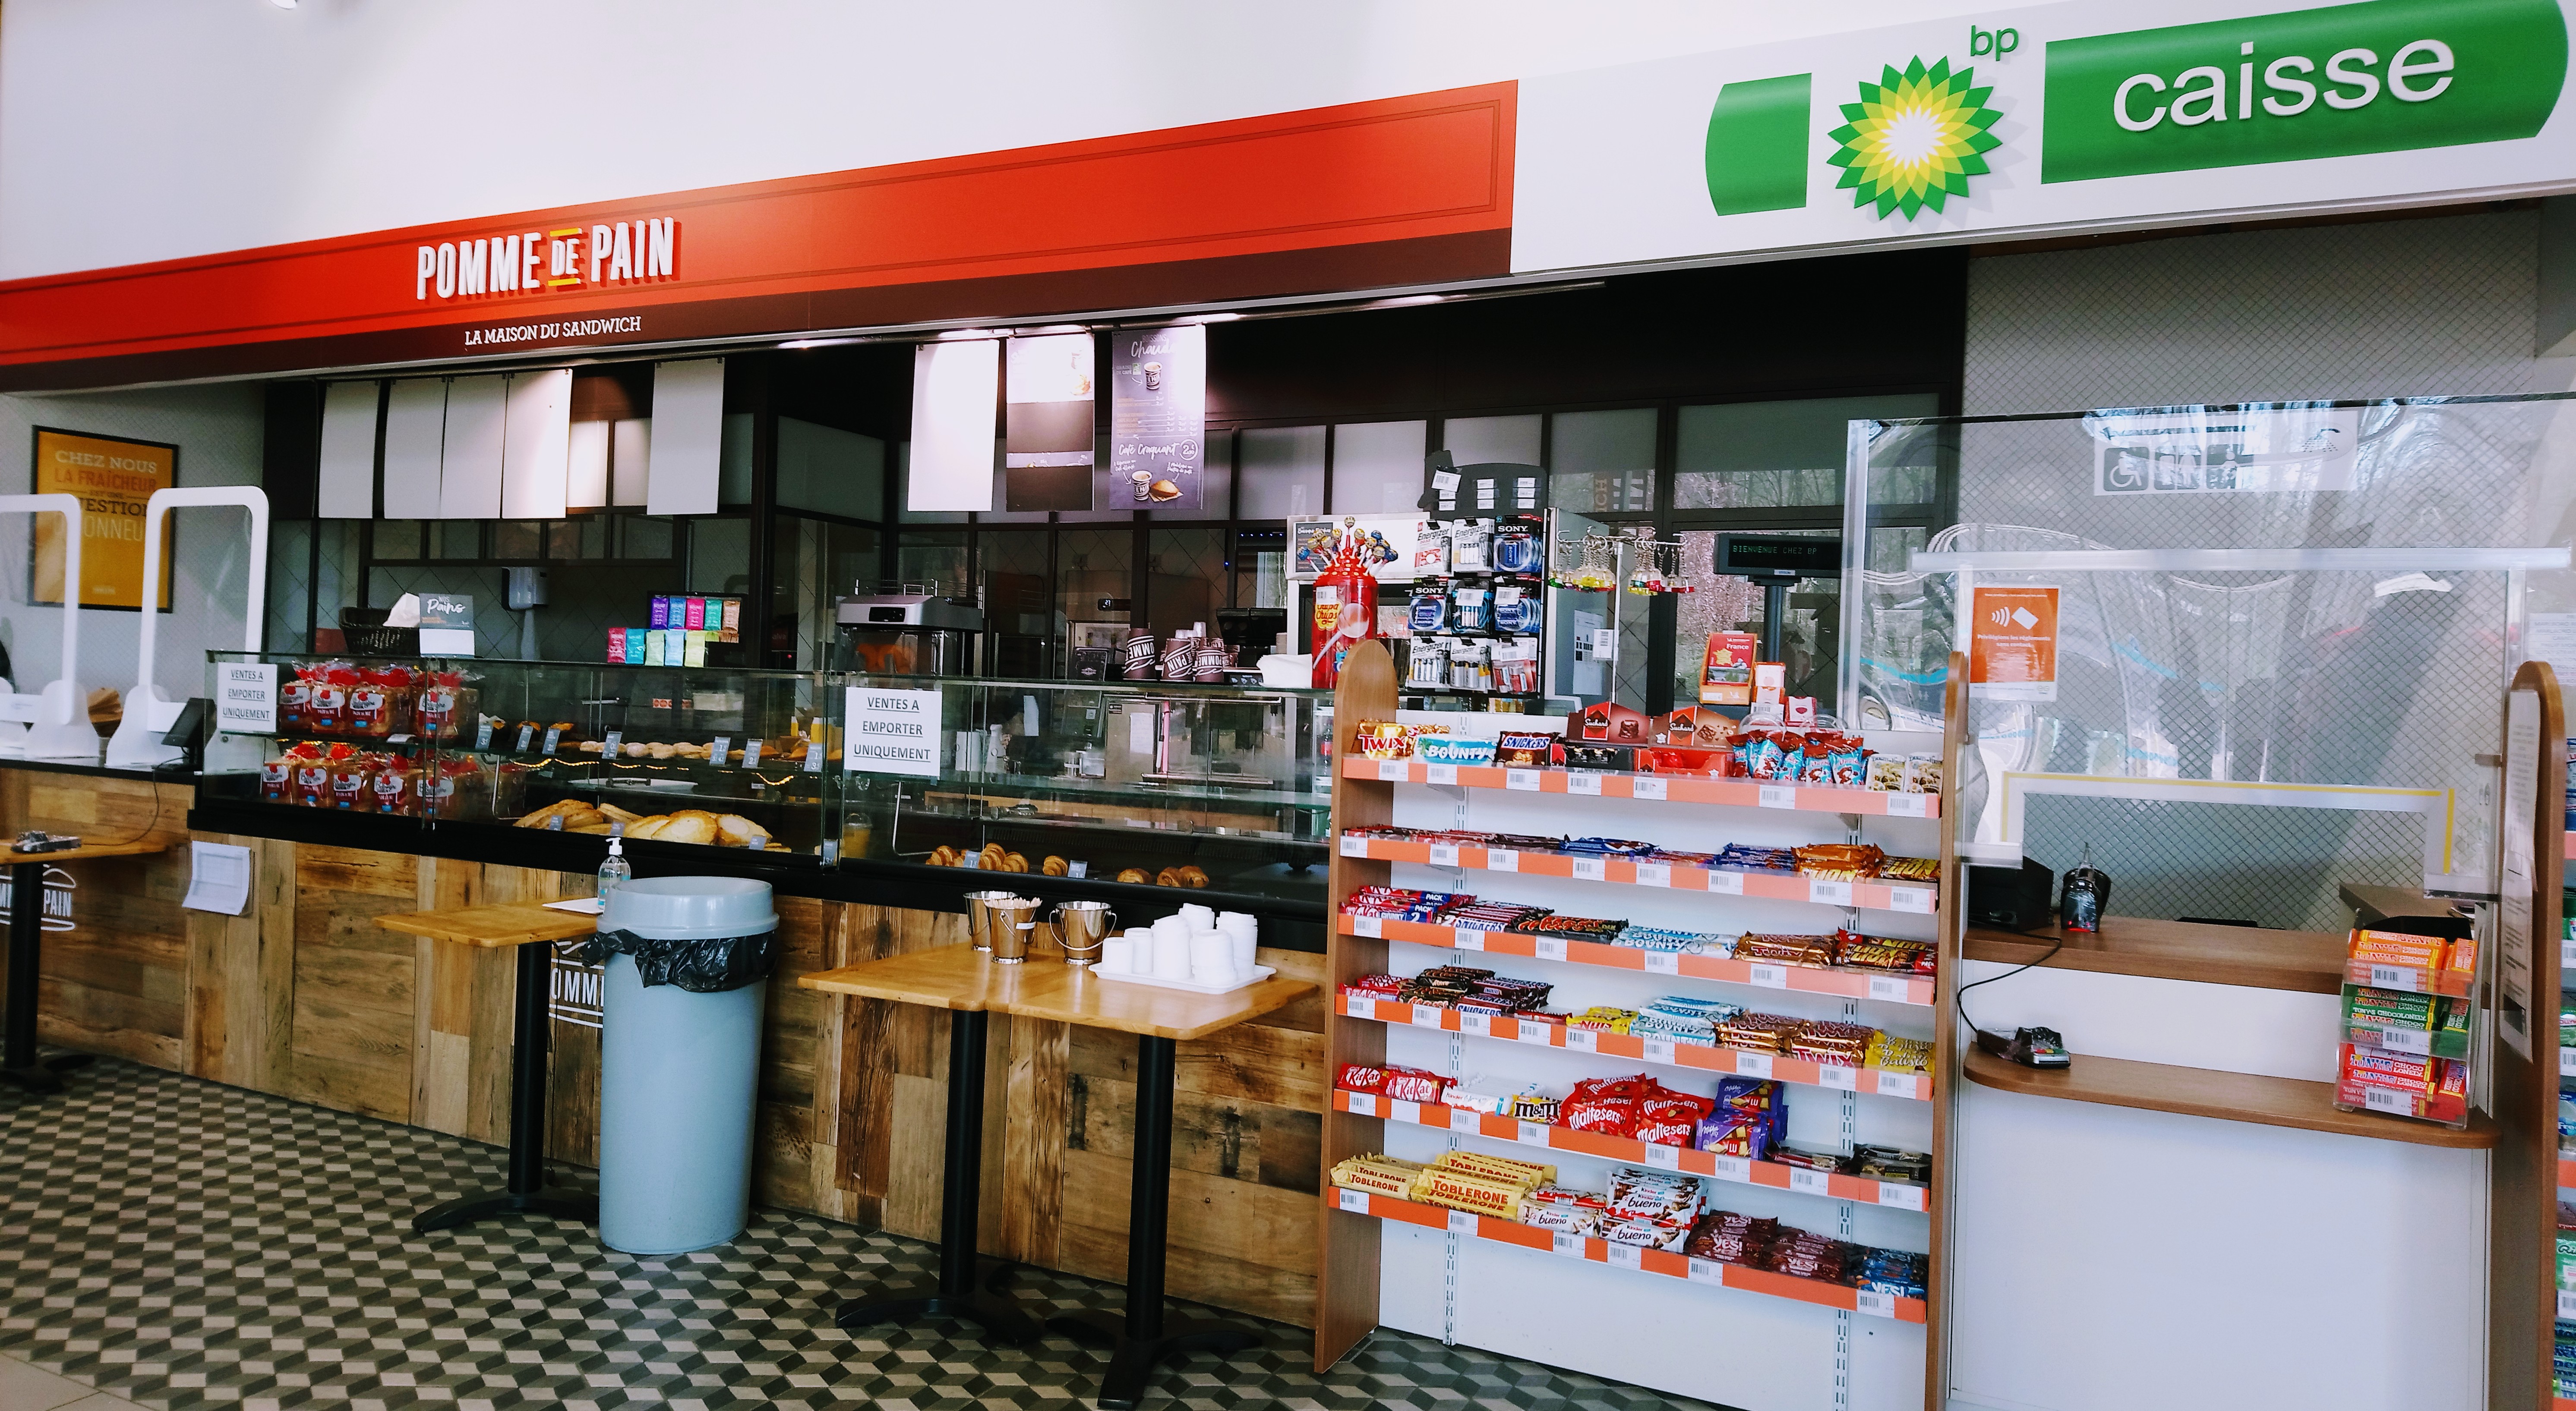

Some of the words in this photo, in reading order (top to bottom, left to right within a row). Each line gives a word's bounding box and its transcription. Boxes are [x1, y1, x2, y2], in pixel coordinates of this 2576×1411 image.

[1970, 25, 2019, 61] bp
[2113, 39, 2455, 133] caisse
[417, 232, 543, 301] POMME
[551, 239, 580, 277] DE
[590, 216, 675, 283] PAIN
[465, 331, 482, 345] LA
[484, 324, 538, 344] MAISON
[540, 323, 560, 339] DU
[562, 316, 642, 337] SANDWICH
[1131, 338, 1177, 358] Chaud
[1118, 444, 1136, 456] Café
[1138, 442, 1181, 460] Craquant
[55, 450, 104, 468] CHEZ
[109, 457, 157, 474] NOUS
[55, 467, 73, 483] LA
[1417, 529, 1450, 541] Energizer
[1454, 524, 1487, 539] Energizer
[1733, 545, 1777, 554] BIENVENUE
[427, 598, 466, 614] Pains
[1316, 610, 1338, 620] Chups
[1412, 641, 1444, 654] Energizer
[1167, 656, 1187, 671] PAIN
[230, 668, 255, 680] VENTES
[257, 670, 263, 680] A
[228, 688, 265, 701] EMPORTER
[867, 696, 908, 710] VENTES
[911, 700, 919, 711] A
[222, 706, 270, 721] UNIQUEMENT
[862, 720, 923, 736] EMPORTER
[1584, 719, 1608, 727] Suchard
[1669, 723, 1695, 732] Suchard
[1358, 734, 1406, 751] TWIX
[1503, 737, 1550, 749] SNICKERS
[853, 744, 931, 761] UNIQUEMENT
[1427, 746, 1489, 760] BOUNTY
[1888, 859, 1940, 876] LION
[1811, 868, 1859, 884] LION
[44, 888, 72, 917] PAIN
[1425, 893, 1443, 902] PACK
[1380, 911, 1406, 921] CHUNKY
[1455, 918, 1506, 932] SNICKERS
[1625, 938, 1686, 949] BOUNTY
[551, 968, 603, 1008] OMM
[1792, 1047, 1854, 1068] TWIX
[1880, 1056, 1928, 1067] Balisto
[2394, 1061, 2424, 1071] CHOCO
[1346, 1068, 1381, 1087] KitKat
[2398, 1077, 2428, 1086] CHOCO
[1397, 1077, 1433, 1099] KitKat
[1568, 1106, 1622, 1130] Maltesers
[1636, 1122, 1691, 1143] Maltesers
[1351, 1174, 1399, 1193] TOBLERONE
[1433, 1180, 1509, 1205] TOBLERONE
[1627, 1198, 1662, 1209] bueno
[1538, 1215, 1567, 1225] bueno
[1724, 1216, 1752, 1225] YES!
[1617, 1228, 1652, 1240] bueno
[1713, 1237, 1743, 1252] YES!
[1788, 1258, 1818, 1271] YES!
[1871, 1282, 1905, 1297] YES!
